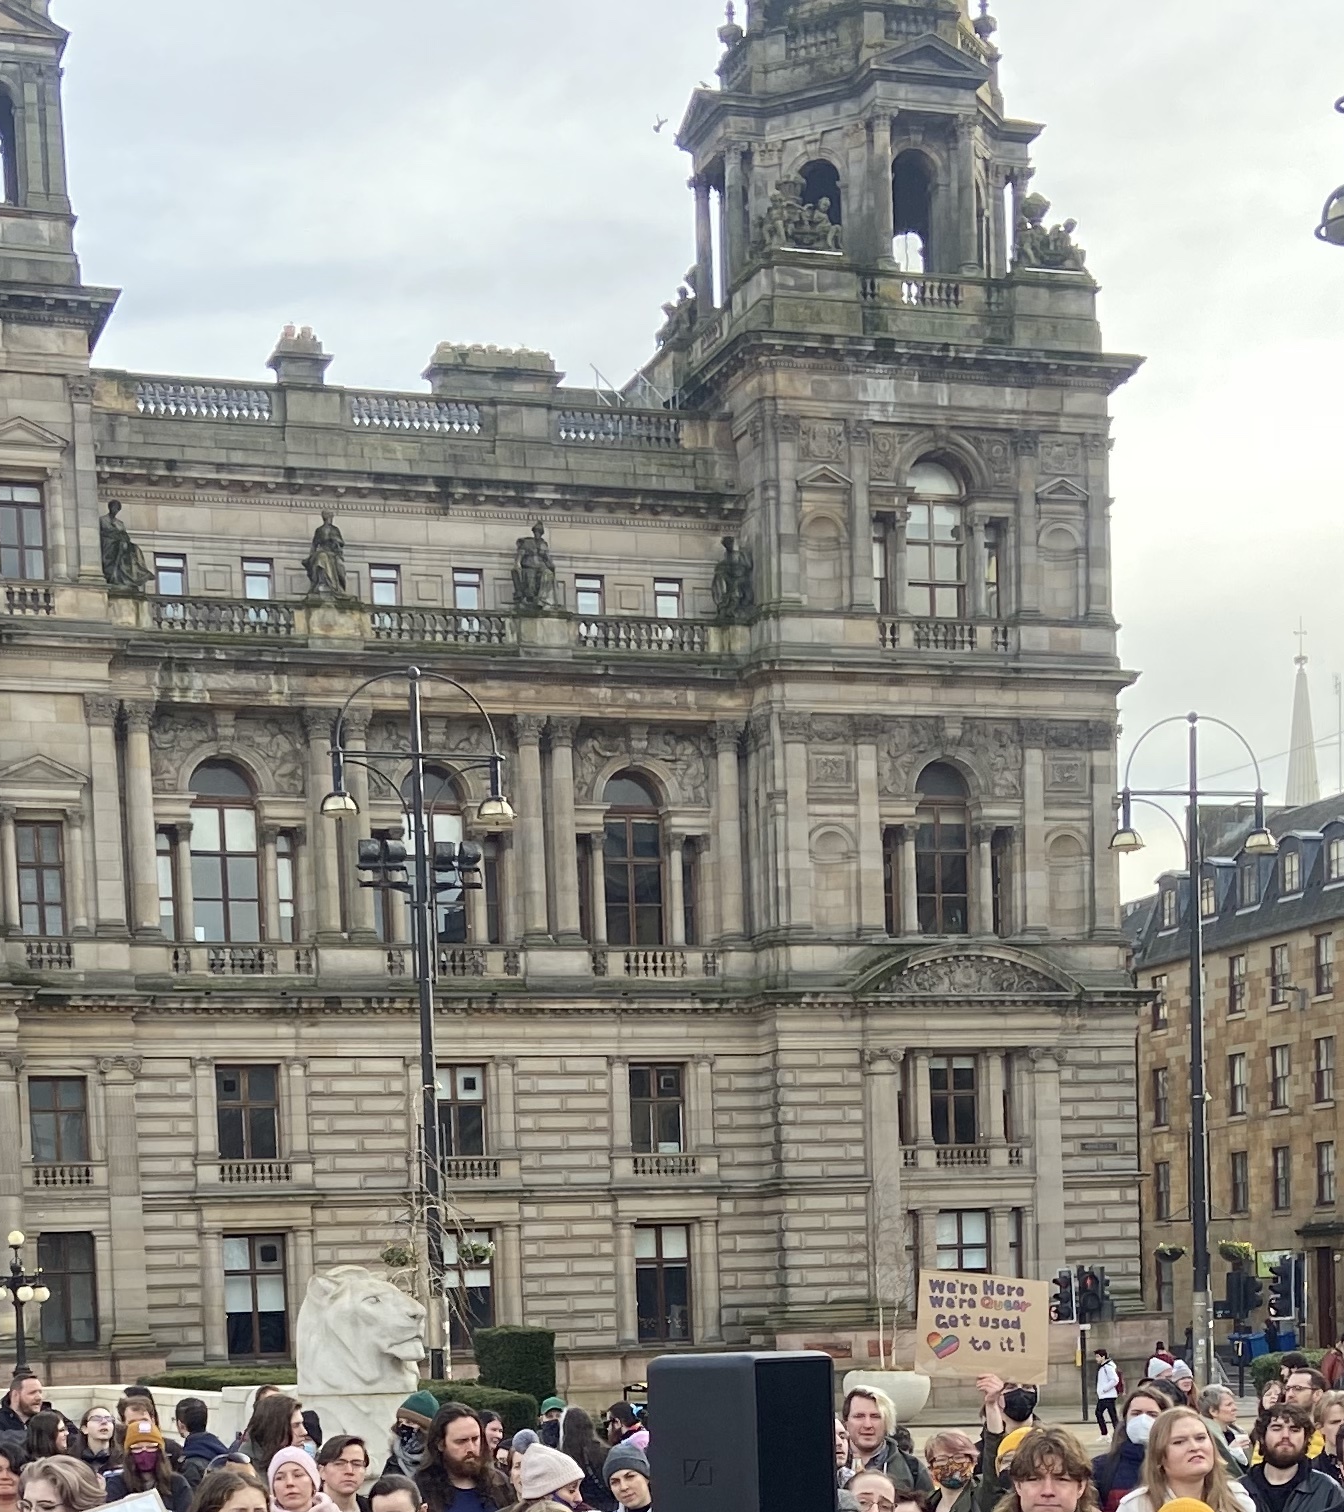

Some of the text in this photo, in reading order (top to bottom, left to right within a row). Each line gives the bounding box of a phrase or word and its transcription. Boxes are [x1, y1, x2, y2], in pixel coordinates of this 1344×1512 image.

[928, 1279, 1025, 1297] We're Here
[928, 1295, 1032, 1312] We're Queer
[935, 1313, 1022, 1330] Get used
[968, 1336, 992, 1352] to
